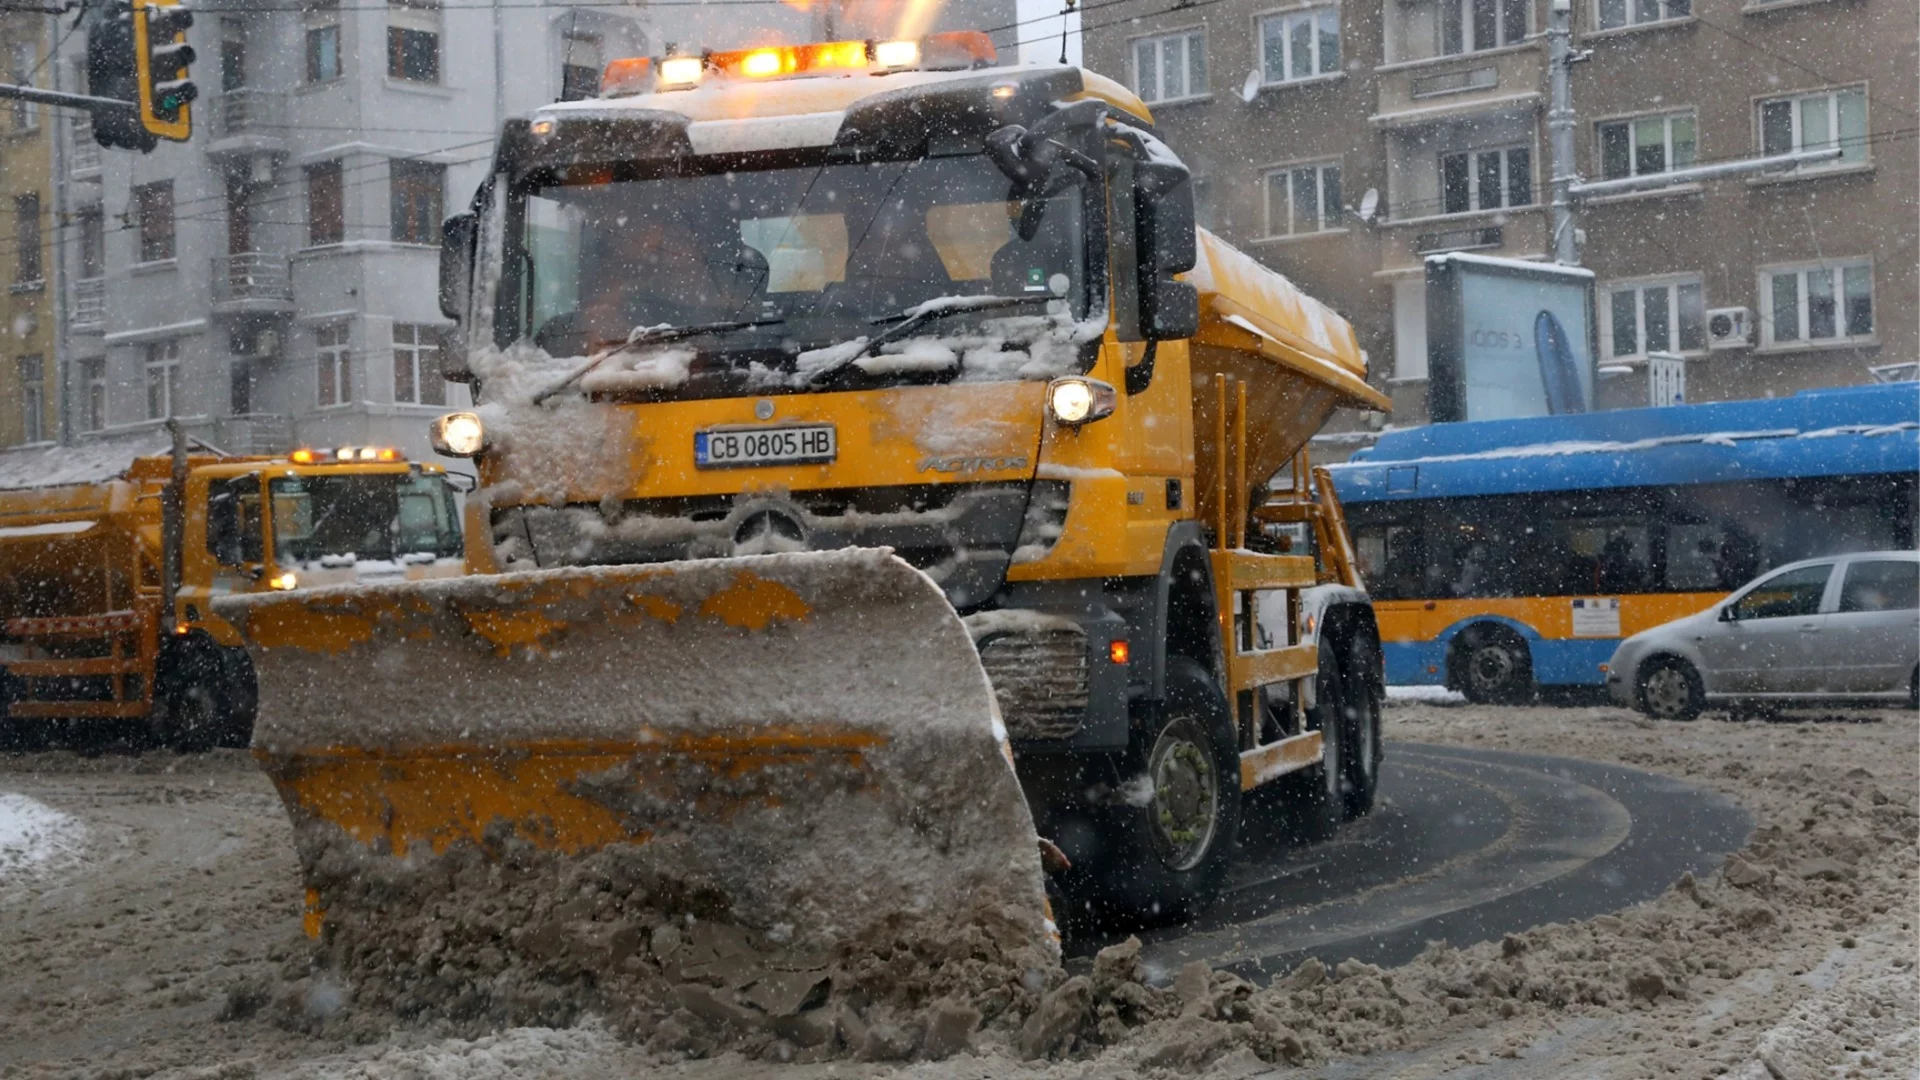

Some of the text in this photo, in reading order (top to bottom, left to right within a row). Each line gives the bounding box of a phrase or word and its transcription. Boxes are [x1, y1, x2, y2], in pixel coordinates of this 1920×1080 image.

[711, 431, 830, 459] CB 0805 HB
